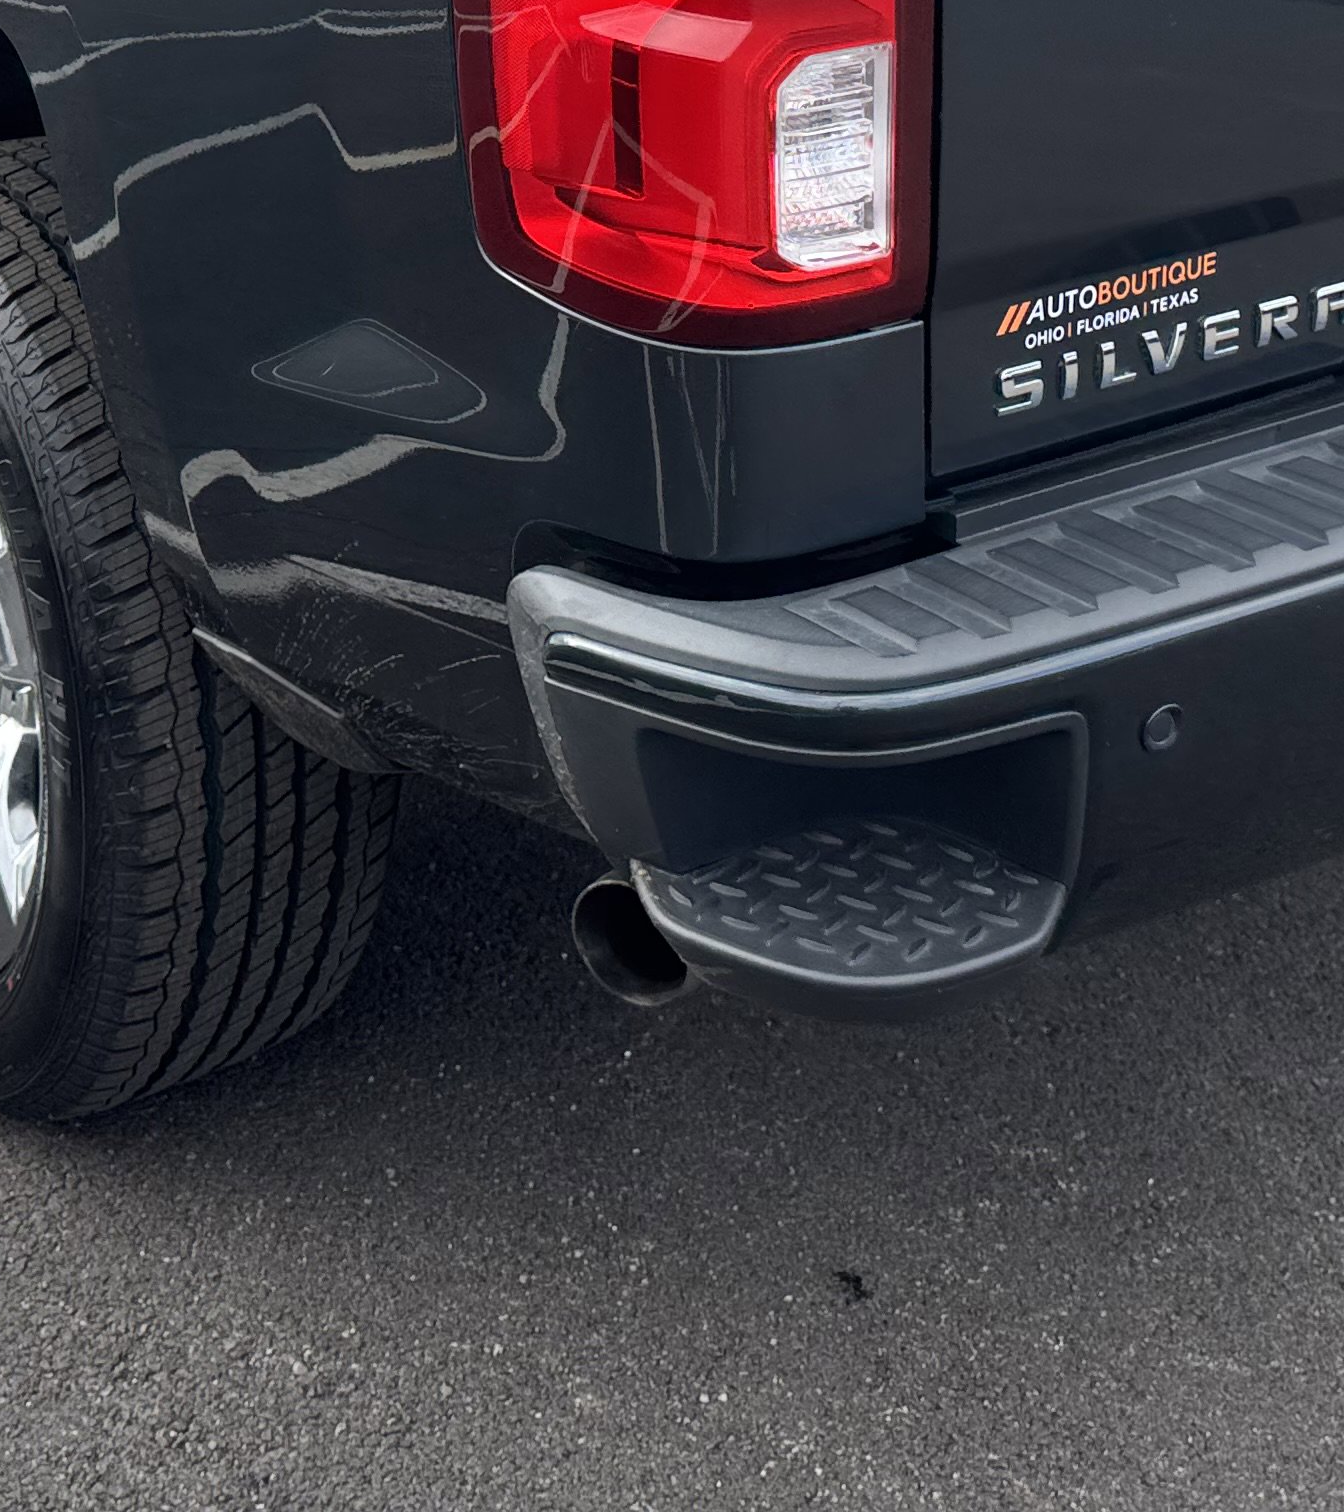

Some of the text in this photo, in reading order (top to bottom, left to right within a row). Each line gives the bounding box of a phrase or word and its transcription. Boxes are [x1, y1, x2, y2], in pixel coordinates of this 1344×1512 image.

[1024, 287, 1199, 350] OHIO FLORIDA TEXAS
